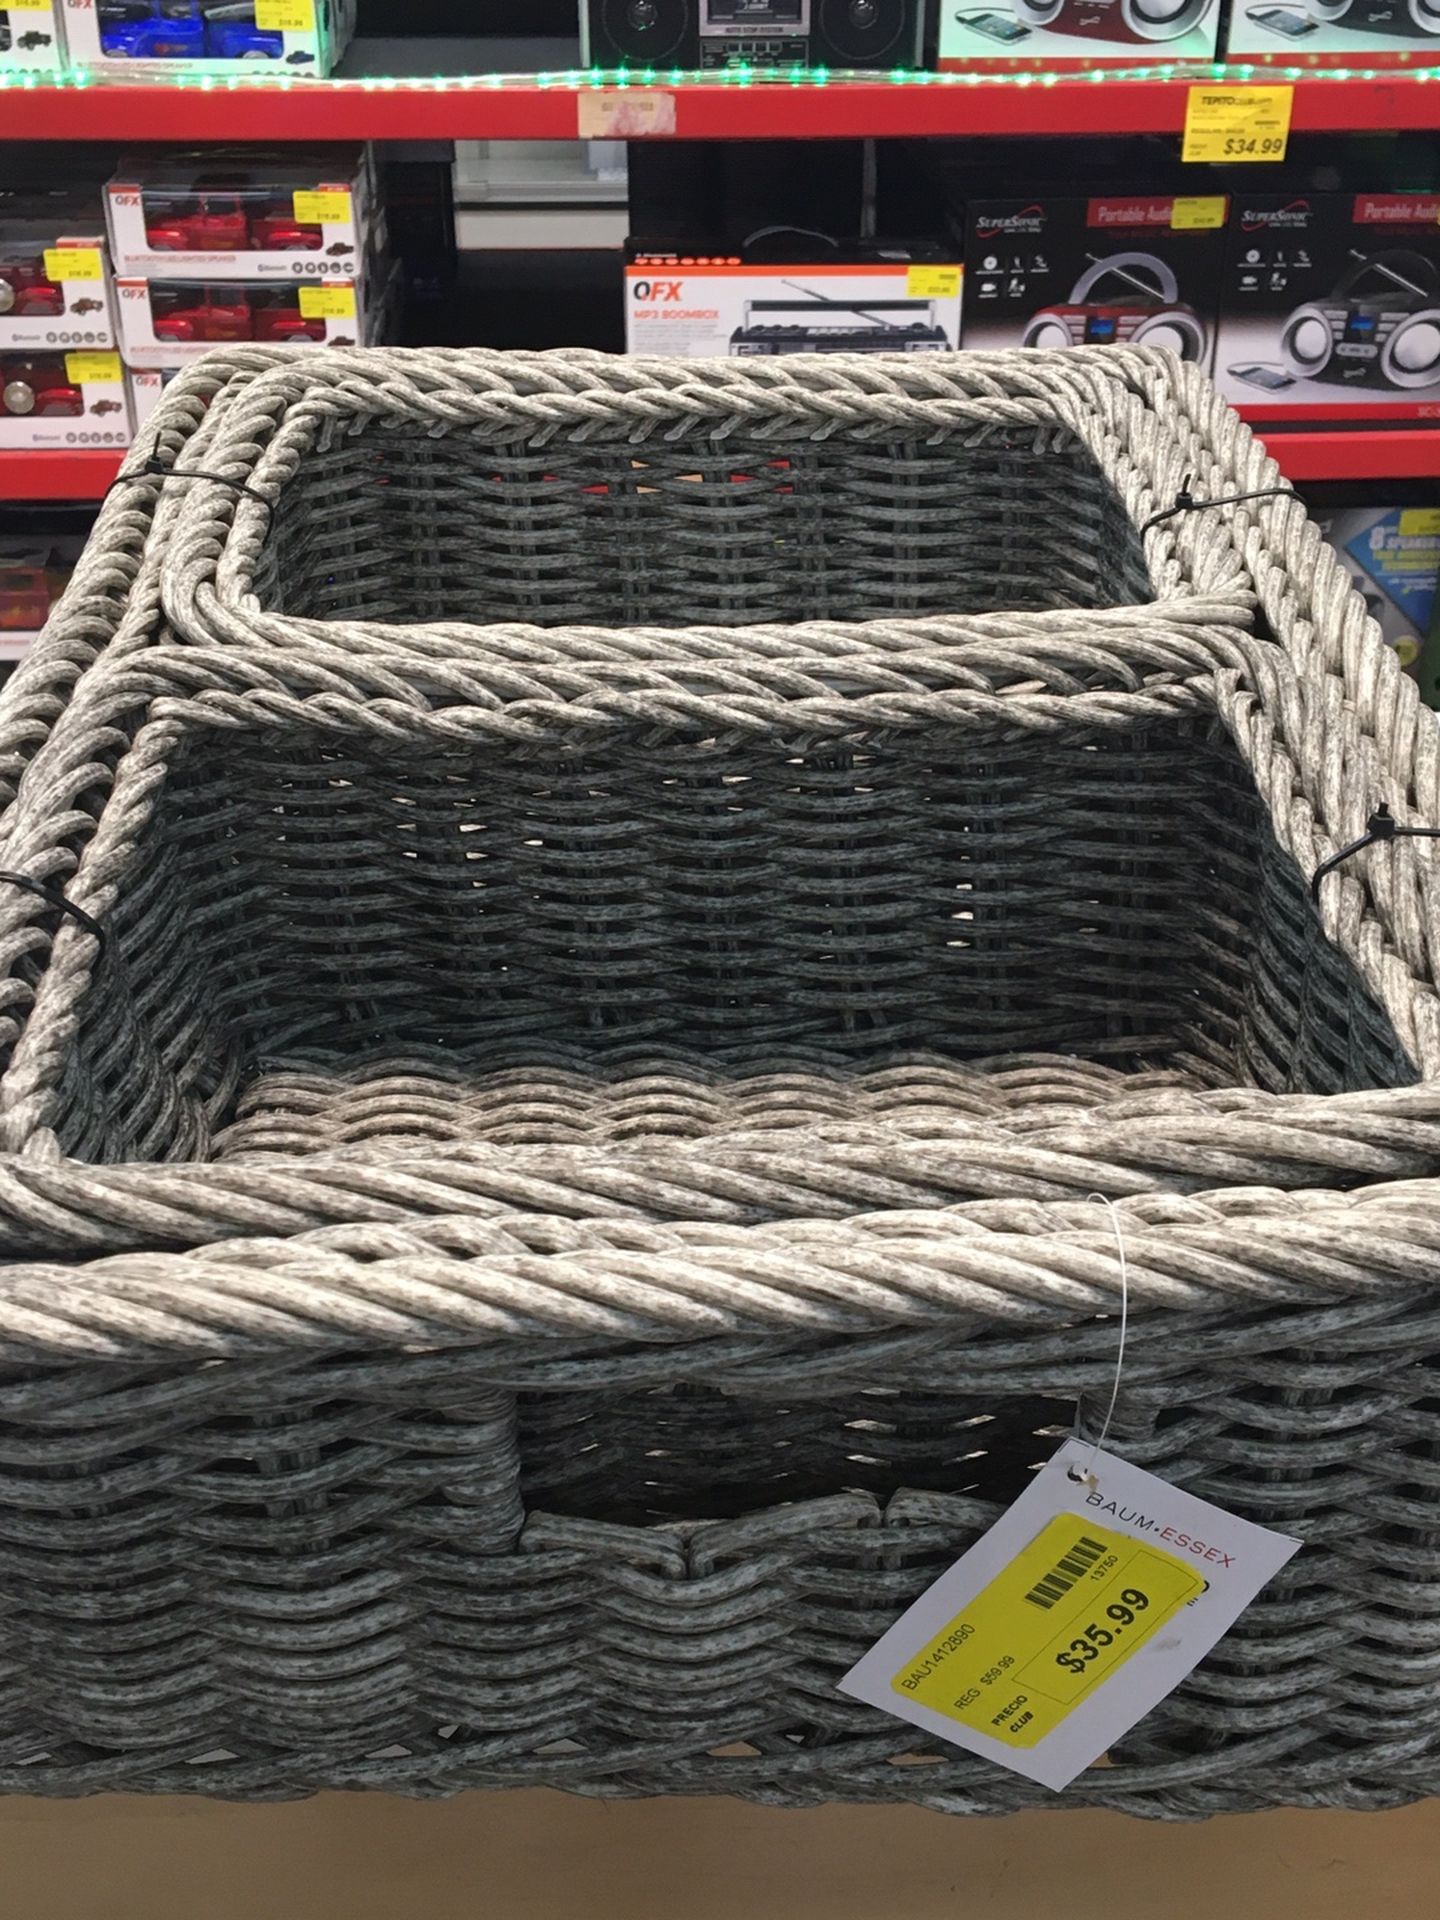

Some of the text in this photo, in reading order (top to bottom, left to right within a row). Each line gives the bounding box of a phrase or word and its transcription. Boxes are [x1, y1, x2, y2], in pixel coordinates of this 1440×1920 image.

[1224, 138, 1283, 155] $34.99
[115, 195, 140, 206] QFX
[1098, 205, 1172, 222] Portable Audi
[1364, 202, 1413, 219] Portable
[122, 288, 145, 299] QFX
[632, 281, 683, 301] QFX
[634, 310, 719, 320] MP3 BOOMBOX
[136, 376, 158, 387] QFX
[1090, 1555, 1118, 1581] 13750
[1056, 1588, 1149, 1673] $35.99
[901, 1623, 976, 1690] BAU1412890
[954, 1655, 1015, 1710] REG $59.99
[991, 1695, 1028, 1726] PRECIO
[1010, 1711, 1034, 1733] CLUB
